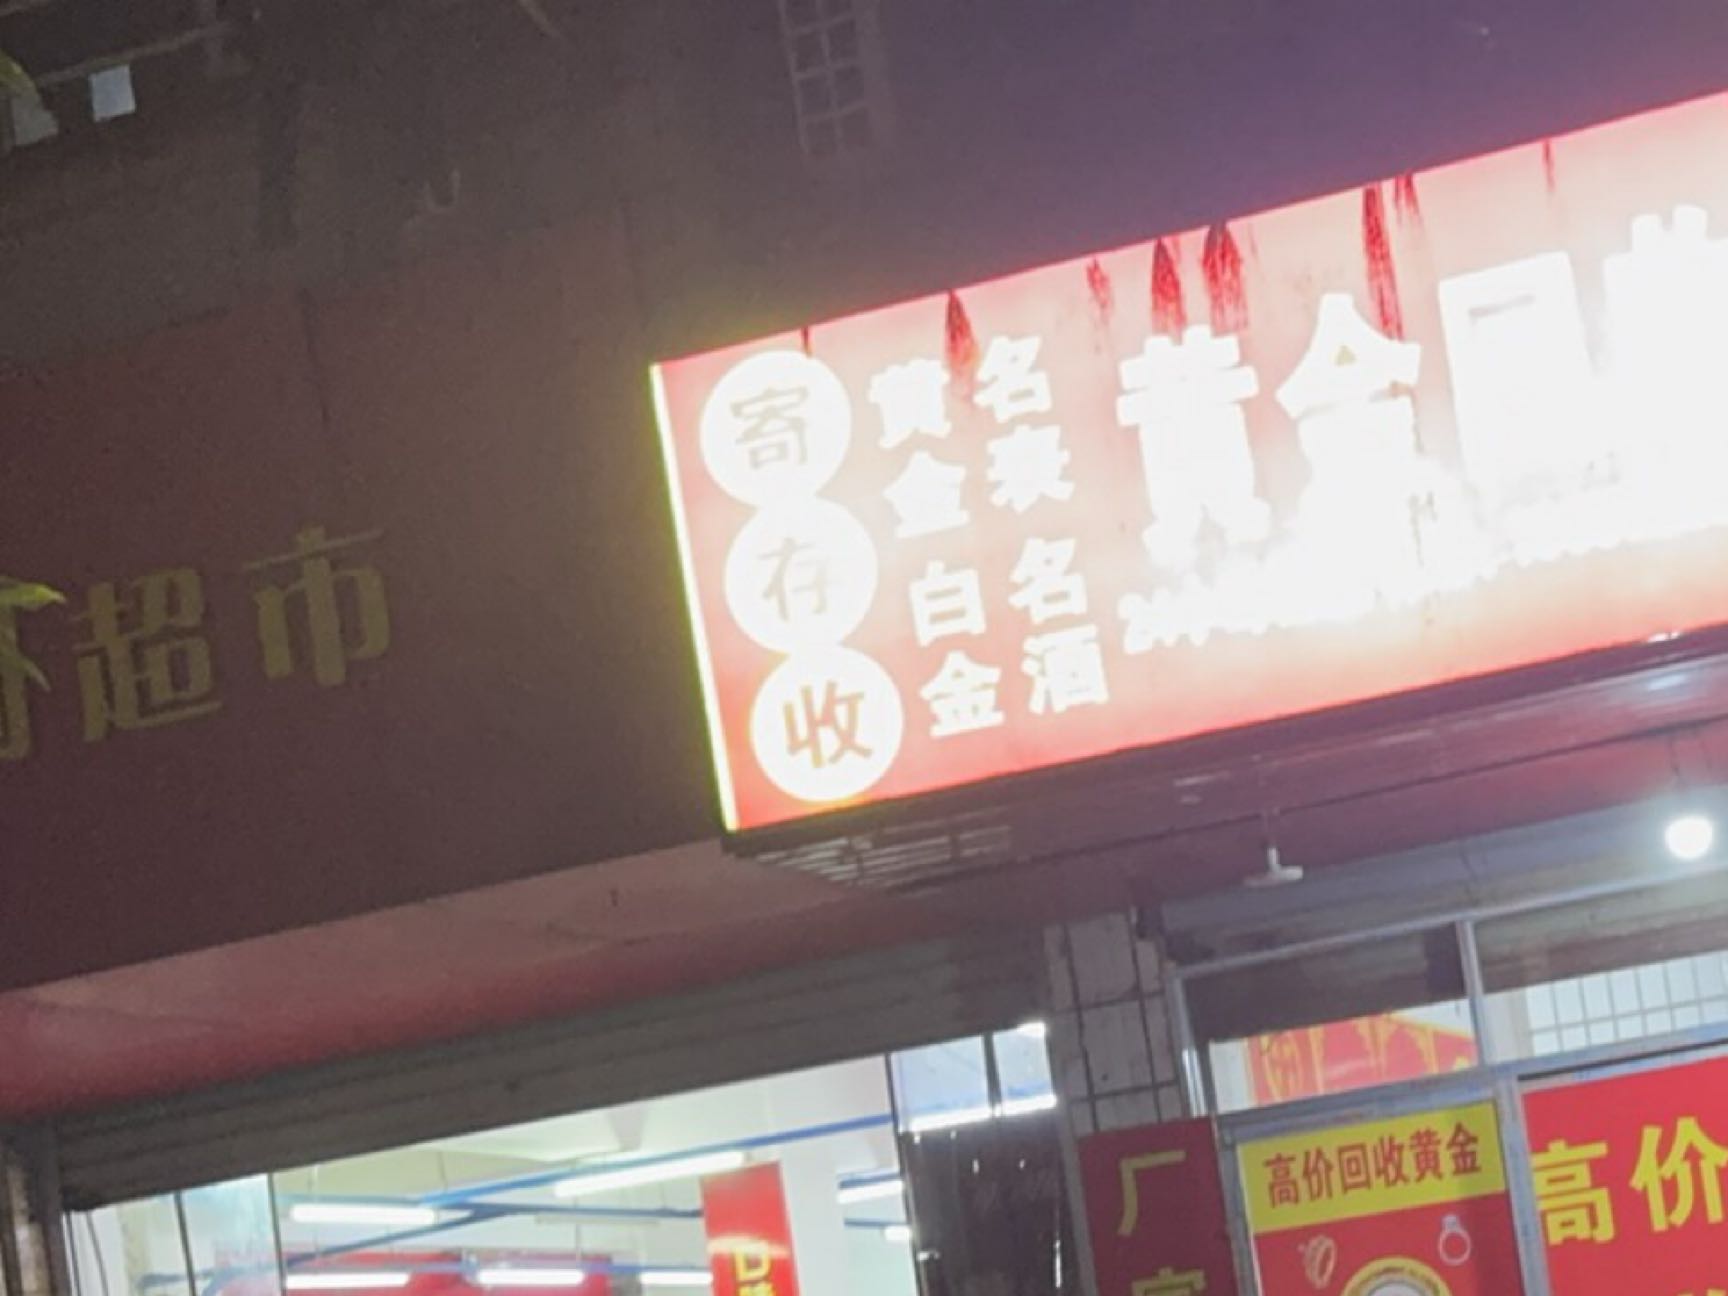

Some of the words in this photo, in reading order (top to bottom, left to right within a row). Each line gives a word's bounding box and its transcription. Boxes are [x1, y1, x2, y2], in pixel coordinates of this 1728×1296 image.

[908, 560, 1002, 735] 白金
[1265, 1122, 1482, 1209] 高价回收黄金
